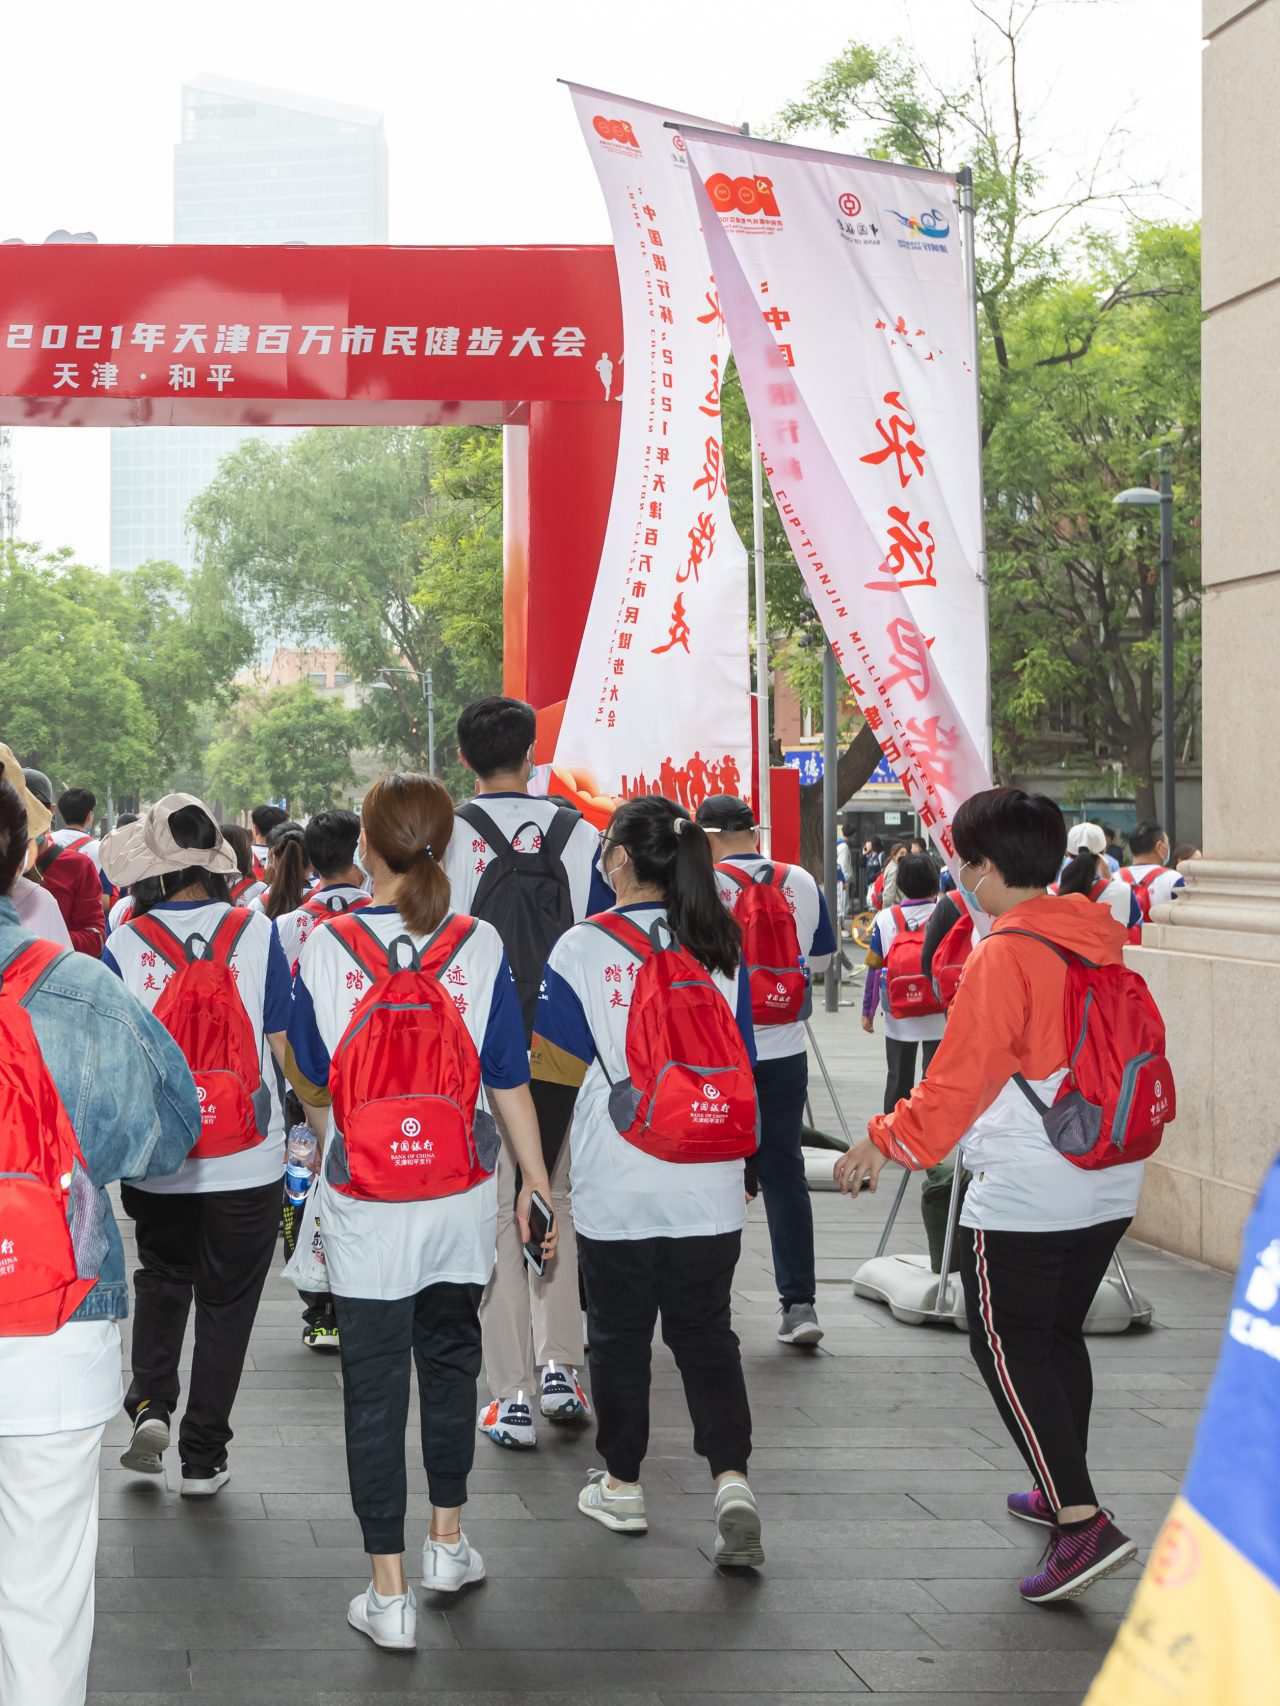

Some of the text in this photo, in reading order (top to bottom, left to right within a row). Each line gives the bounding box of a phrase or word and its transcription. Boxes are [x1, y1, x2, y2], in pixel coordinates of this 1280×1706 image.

[52, 361, 236, 391] 天津·和平
[691, 1100, 731, 1113] 中国银行
[390, 1139, 435, 1154] 中国银行
